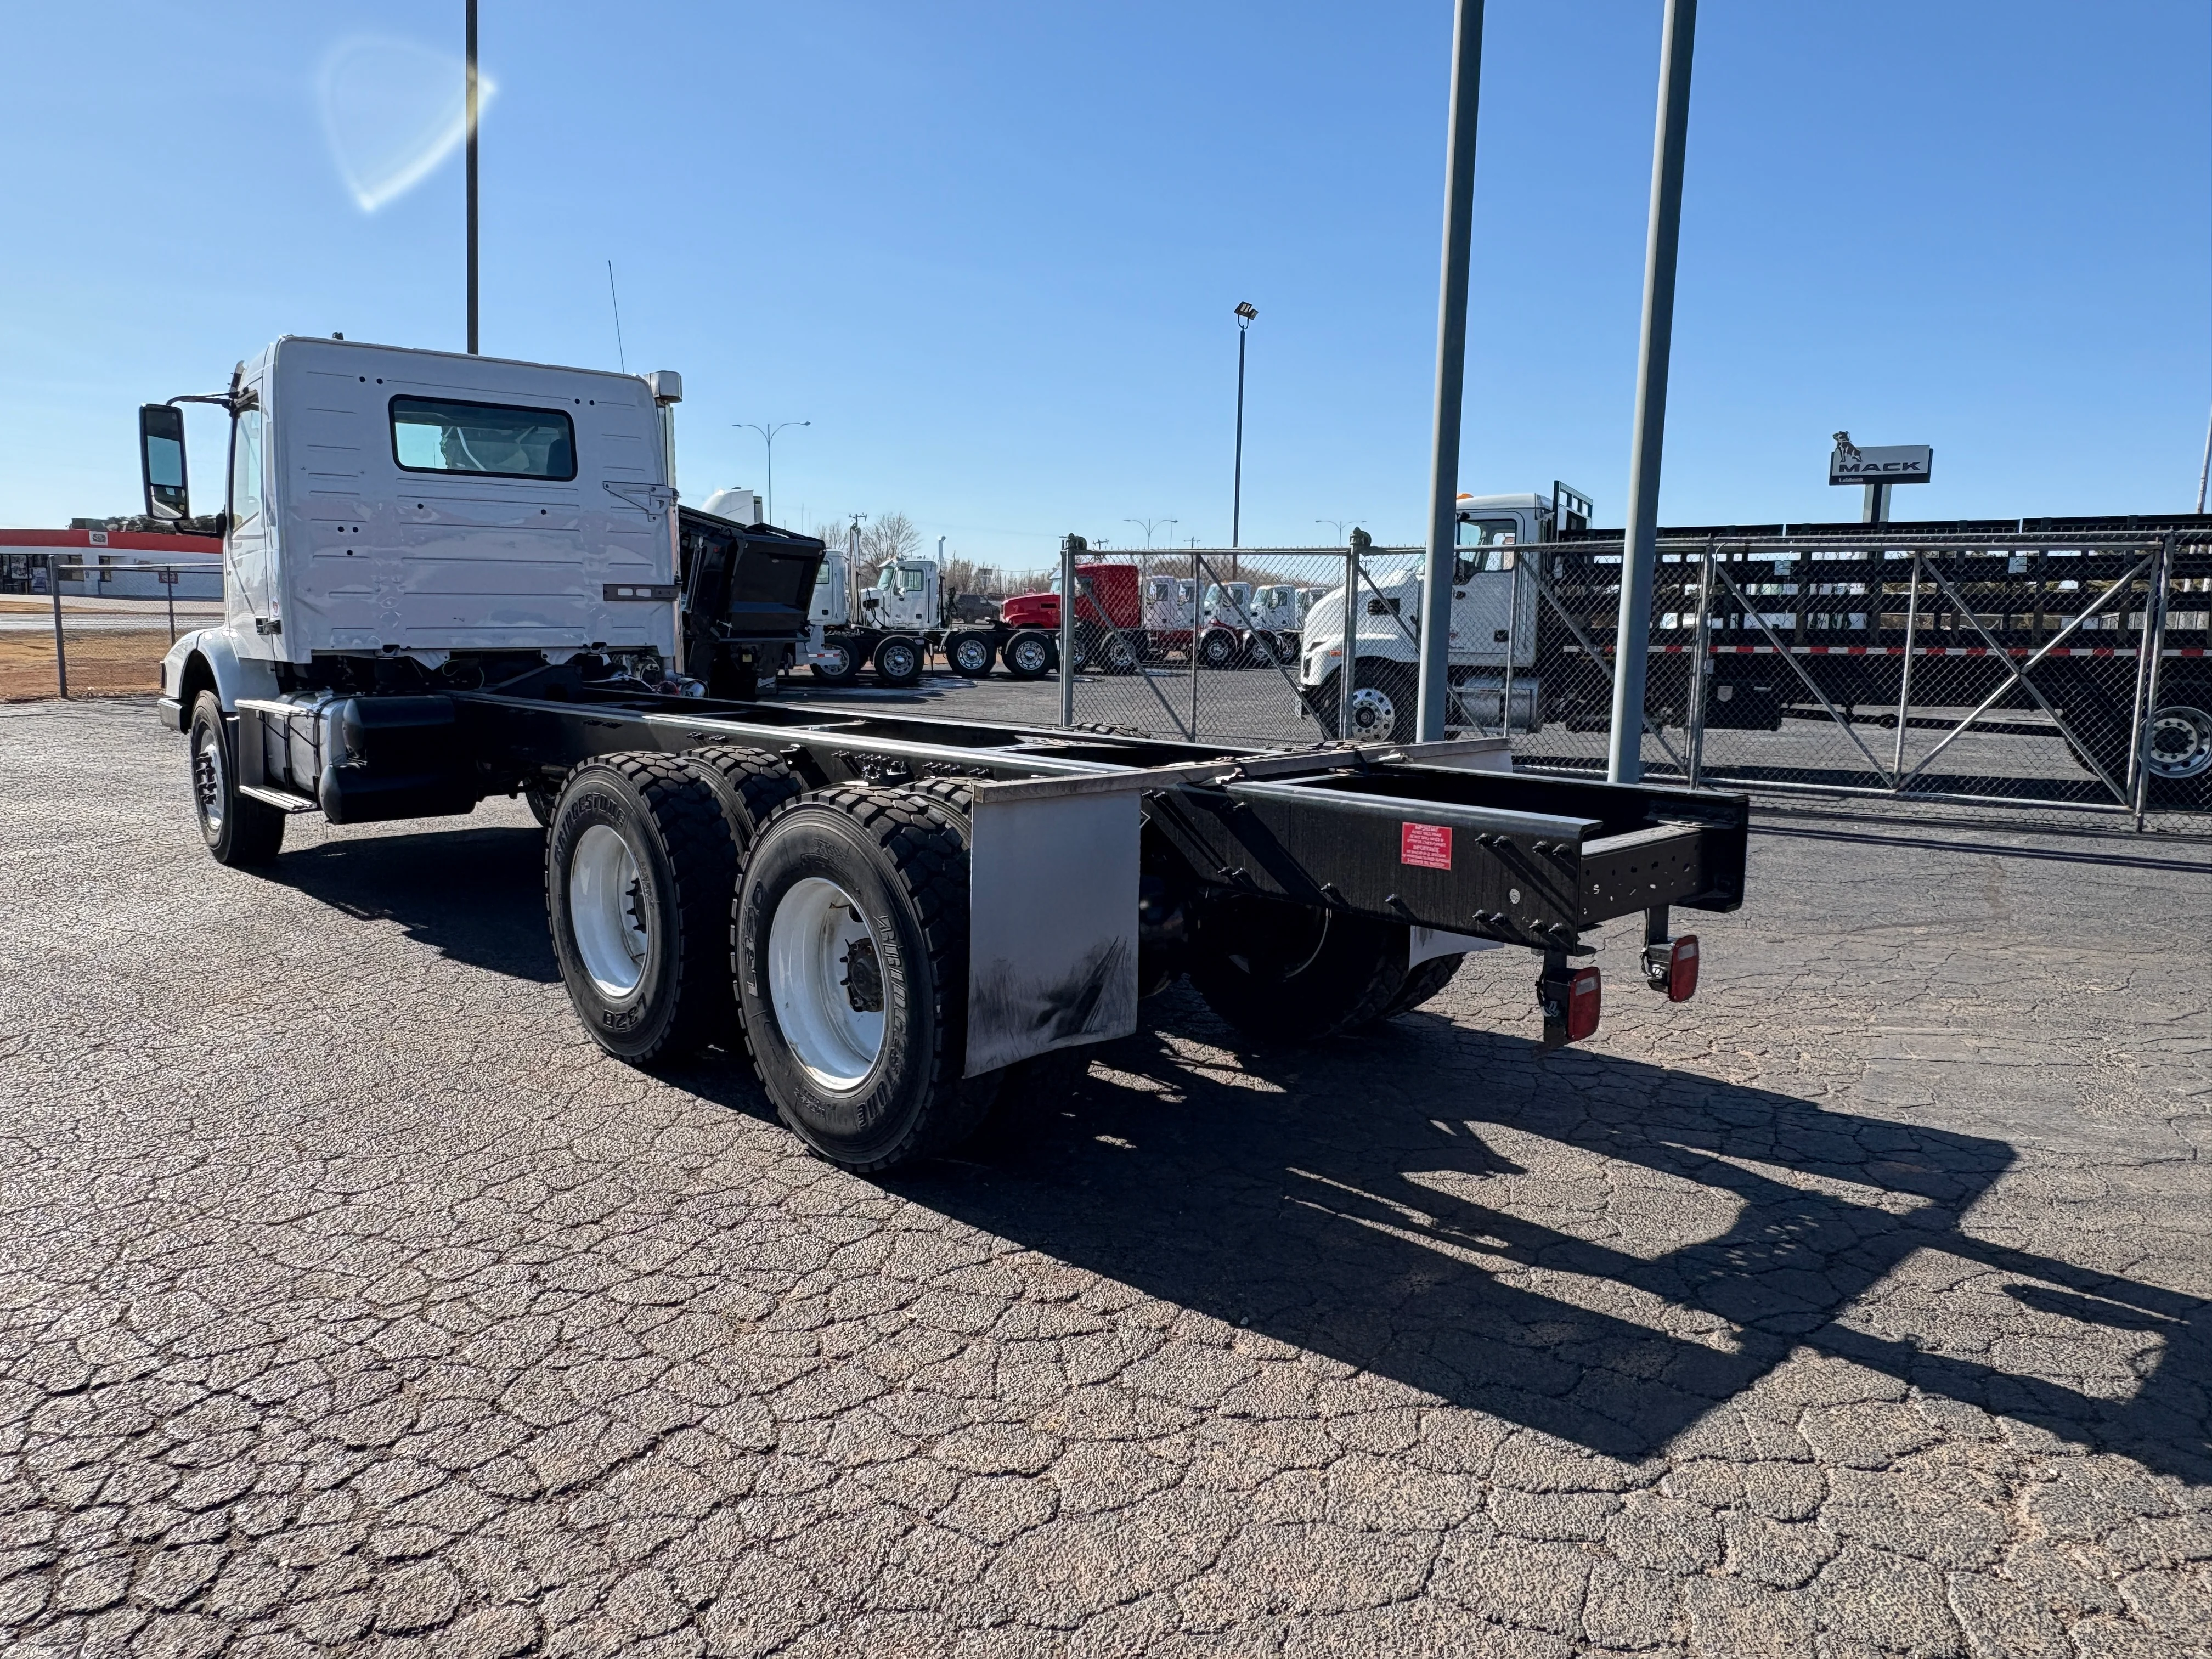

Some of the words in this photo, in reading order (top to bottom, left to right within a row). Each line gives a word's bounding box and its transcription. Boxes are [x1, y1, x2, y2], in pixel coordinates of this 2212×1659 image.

[1839, 462, 1921, 472] MACK
[554, 792, 627, 866] BRIDGESTONE
[603, 992, 647, 1029] L320
